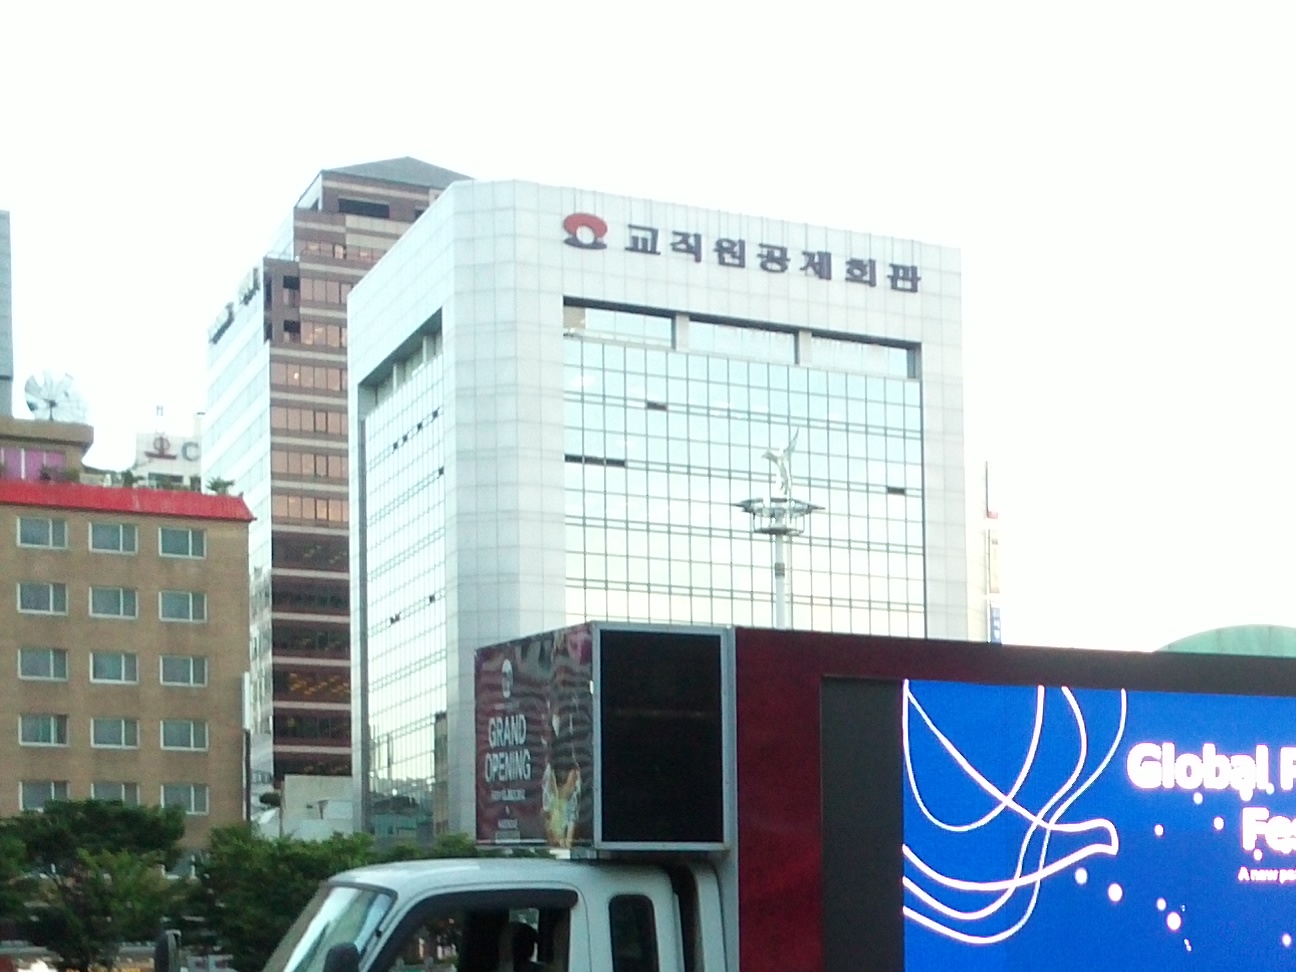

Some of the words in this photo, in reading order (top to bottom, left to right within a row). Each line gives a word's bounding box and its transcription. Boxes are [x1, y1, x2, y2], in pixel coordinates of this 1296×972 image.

[625, 223, 921, 293] 교직원공제회관
[488, 714, 527, 749] GRAND
[485, 749, 531, 783] OPENING
[1127, 742, 1269, 790] Global
